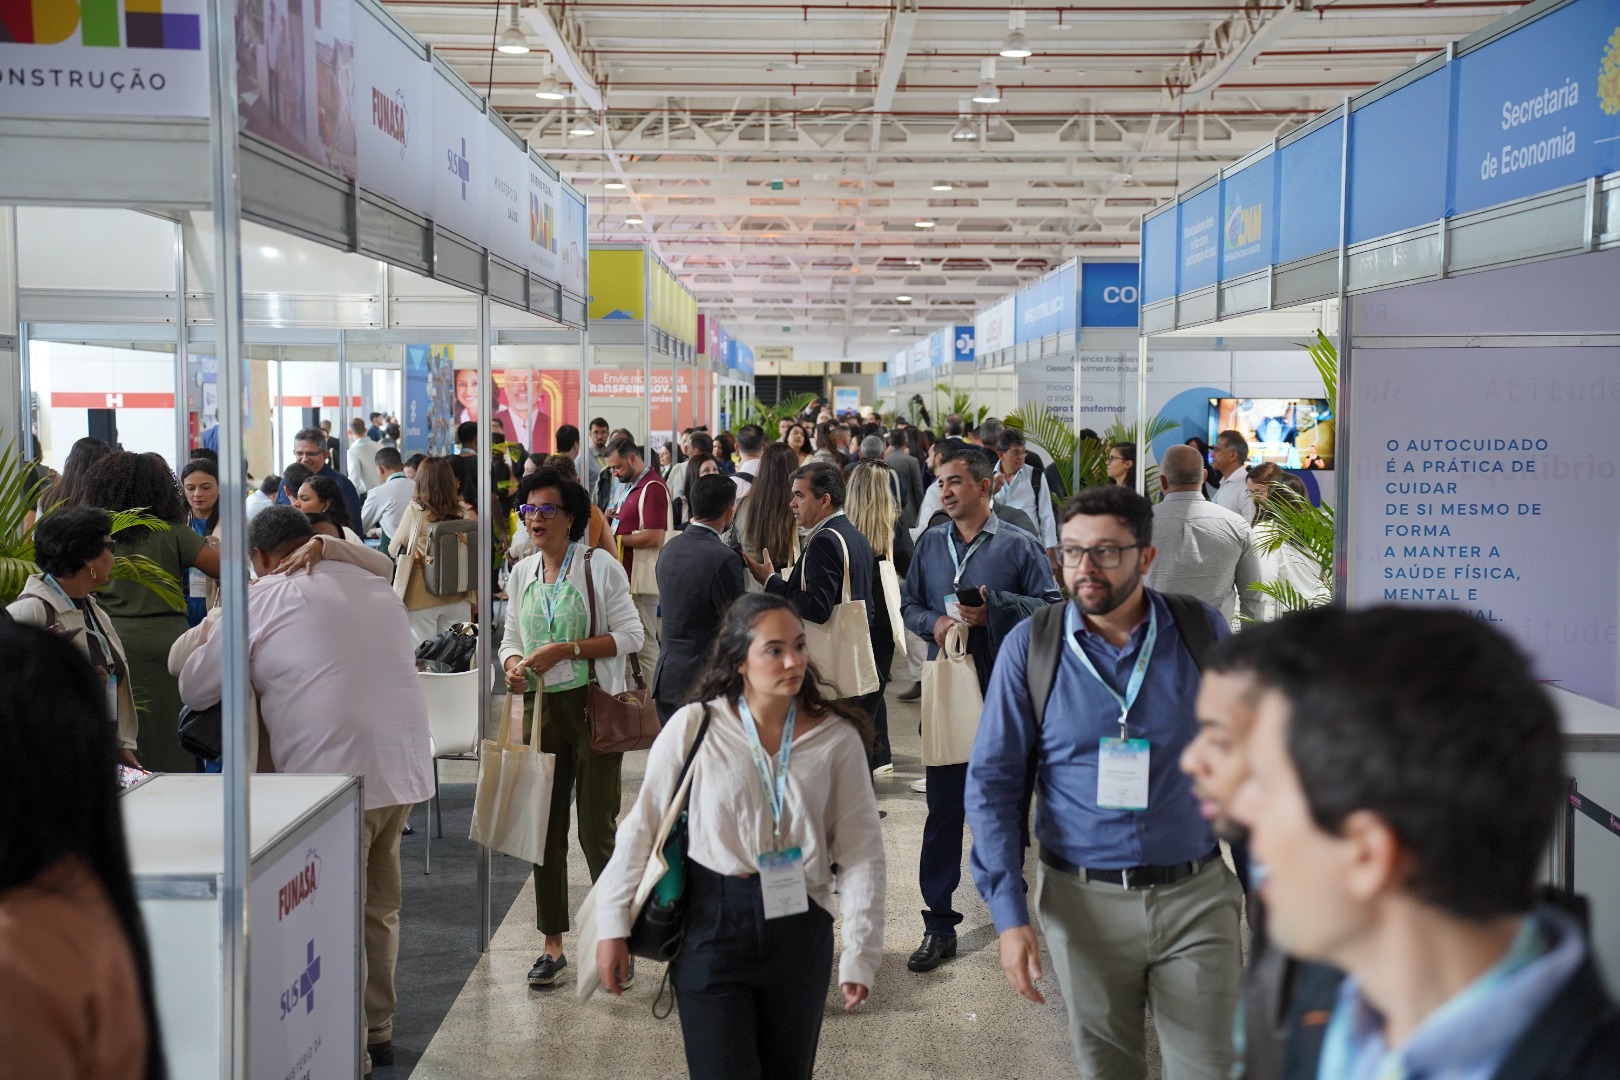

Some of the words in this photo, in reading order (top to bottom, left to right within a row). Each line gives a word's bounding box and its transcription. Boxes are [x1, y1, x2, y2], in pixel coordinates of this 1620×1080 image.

[0, 67, 167, 94] NSTRUÇÃO
[1502, 77, 1579, 131] Secretaria
[371, 86, 406, 146] FUNASA
[1480, 151, 1498, 181] de
[1501, 126, 1577, 175] Economia
[447, 148, 458, 176] SUS
[1070, 355, 1104, 363] Aência
[1046, 365, 1115, 373] Desenvlvimento
[603, 373, 630, 384] Envie
[630, 374, 669, 384] recrsos
[105, 393, 124, 409] H
[1070, 404, 1127, 413] tansformar
[1386, 439, 1400, 452] O
[1406, 438, 1549, 452] AUTOCUIDADO
[1386, 457, 1396, 473] É
[1403, 460, 1416, 473] A
[1423, 457, 1504, 473] PRÁTICA
[1511, 460, 1536, 473] DE
[1385, 482, 1458, 495] CUIDAR
[1385, 503, 1409, 516] DE
[1416, 503, 1433, 516] SI
[1441, 503, 1510, 516] MESMO
[1517, 503, 1542, 516] DE
[1384, 524, 1451, 537] FORMA
[1383, 545, 1396, 558] A
[1403, 545, 1482, 558] MANTER
[1488, 545, 1501, 558] A
[1384, 563, 1447, 579] SAÚDE
[1454, 563, 1521, 581] FÍSICA,
[1384, 588, 1460, 600] MENTAL
[1468, 588, 1478, 601] E
[278, 861, 318, 922] FUNASA
[280, 979, 299, 1021] SUS
